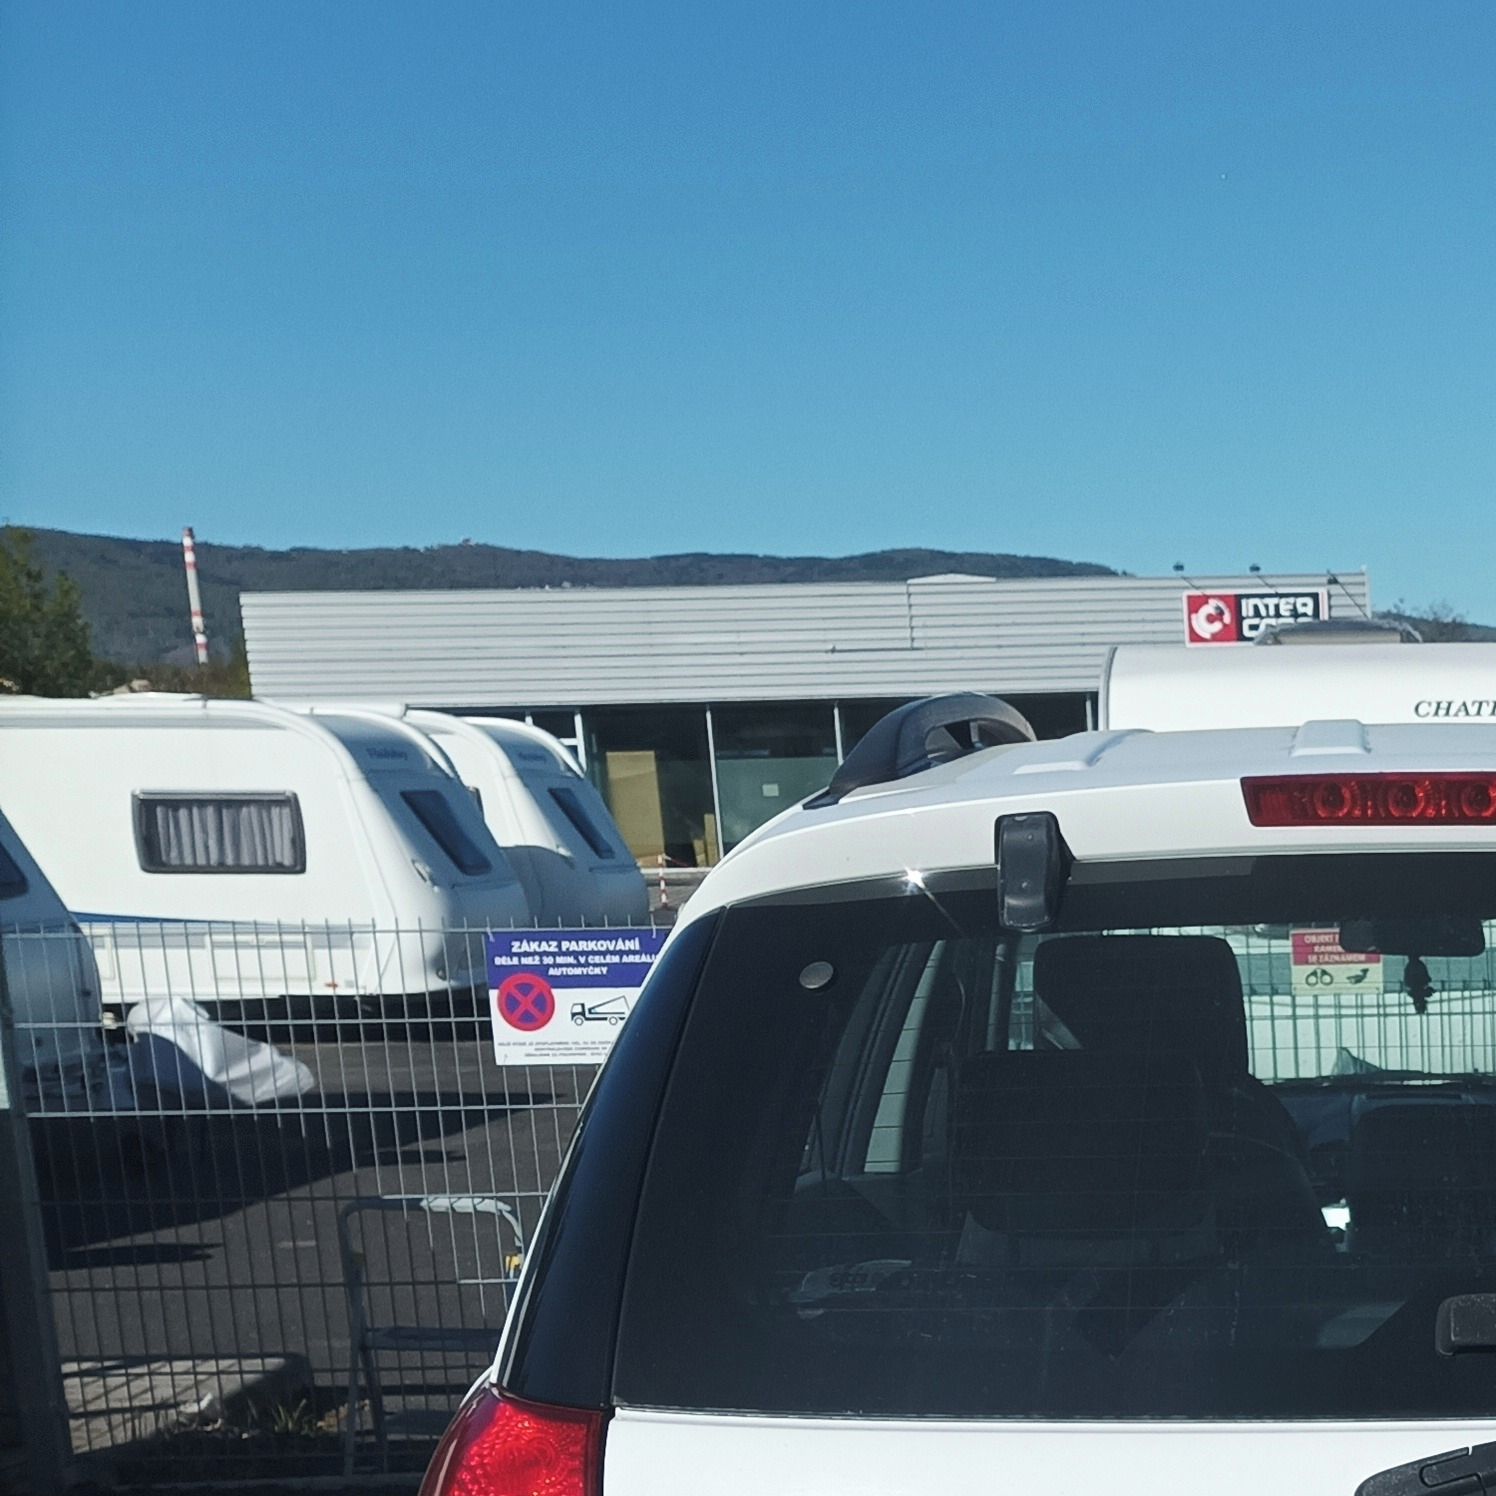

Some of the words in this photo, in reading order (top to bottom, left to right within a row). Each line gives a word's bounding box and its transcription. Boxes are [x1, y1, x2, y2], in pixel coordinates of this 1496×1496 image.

[1241, 596, 1314, 618] INTER
[511, 939, 559, 953] ZÁKAZ
[561, 937, 640, 951] PARKOVÁNÍ
[542, 955, 554, 965] 30
[579, 955, 586, 964] V
